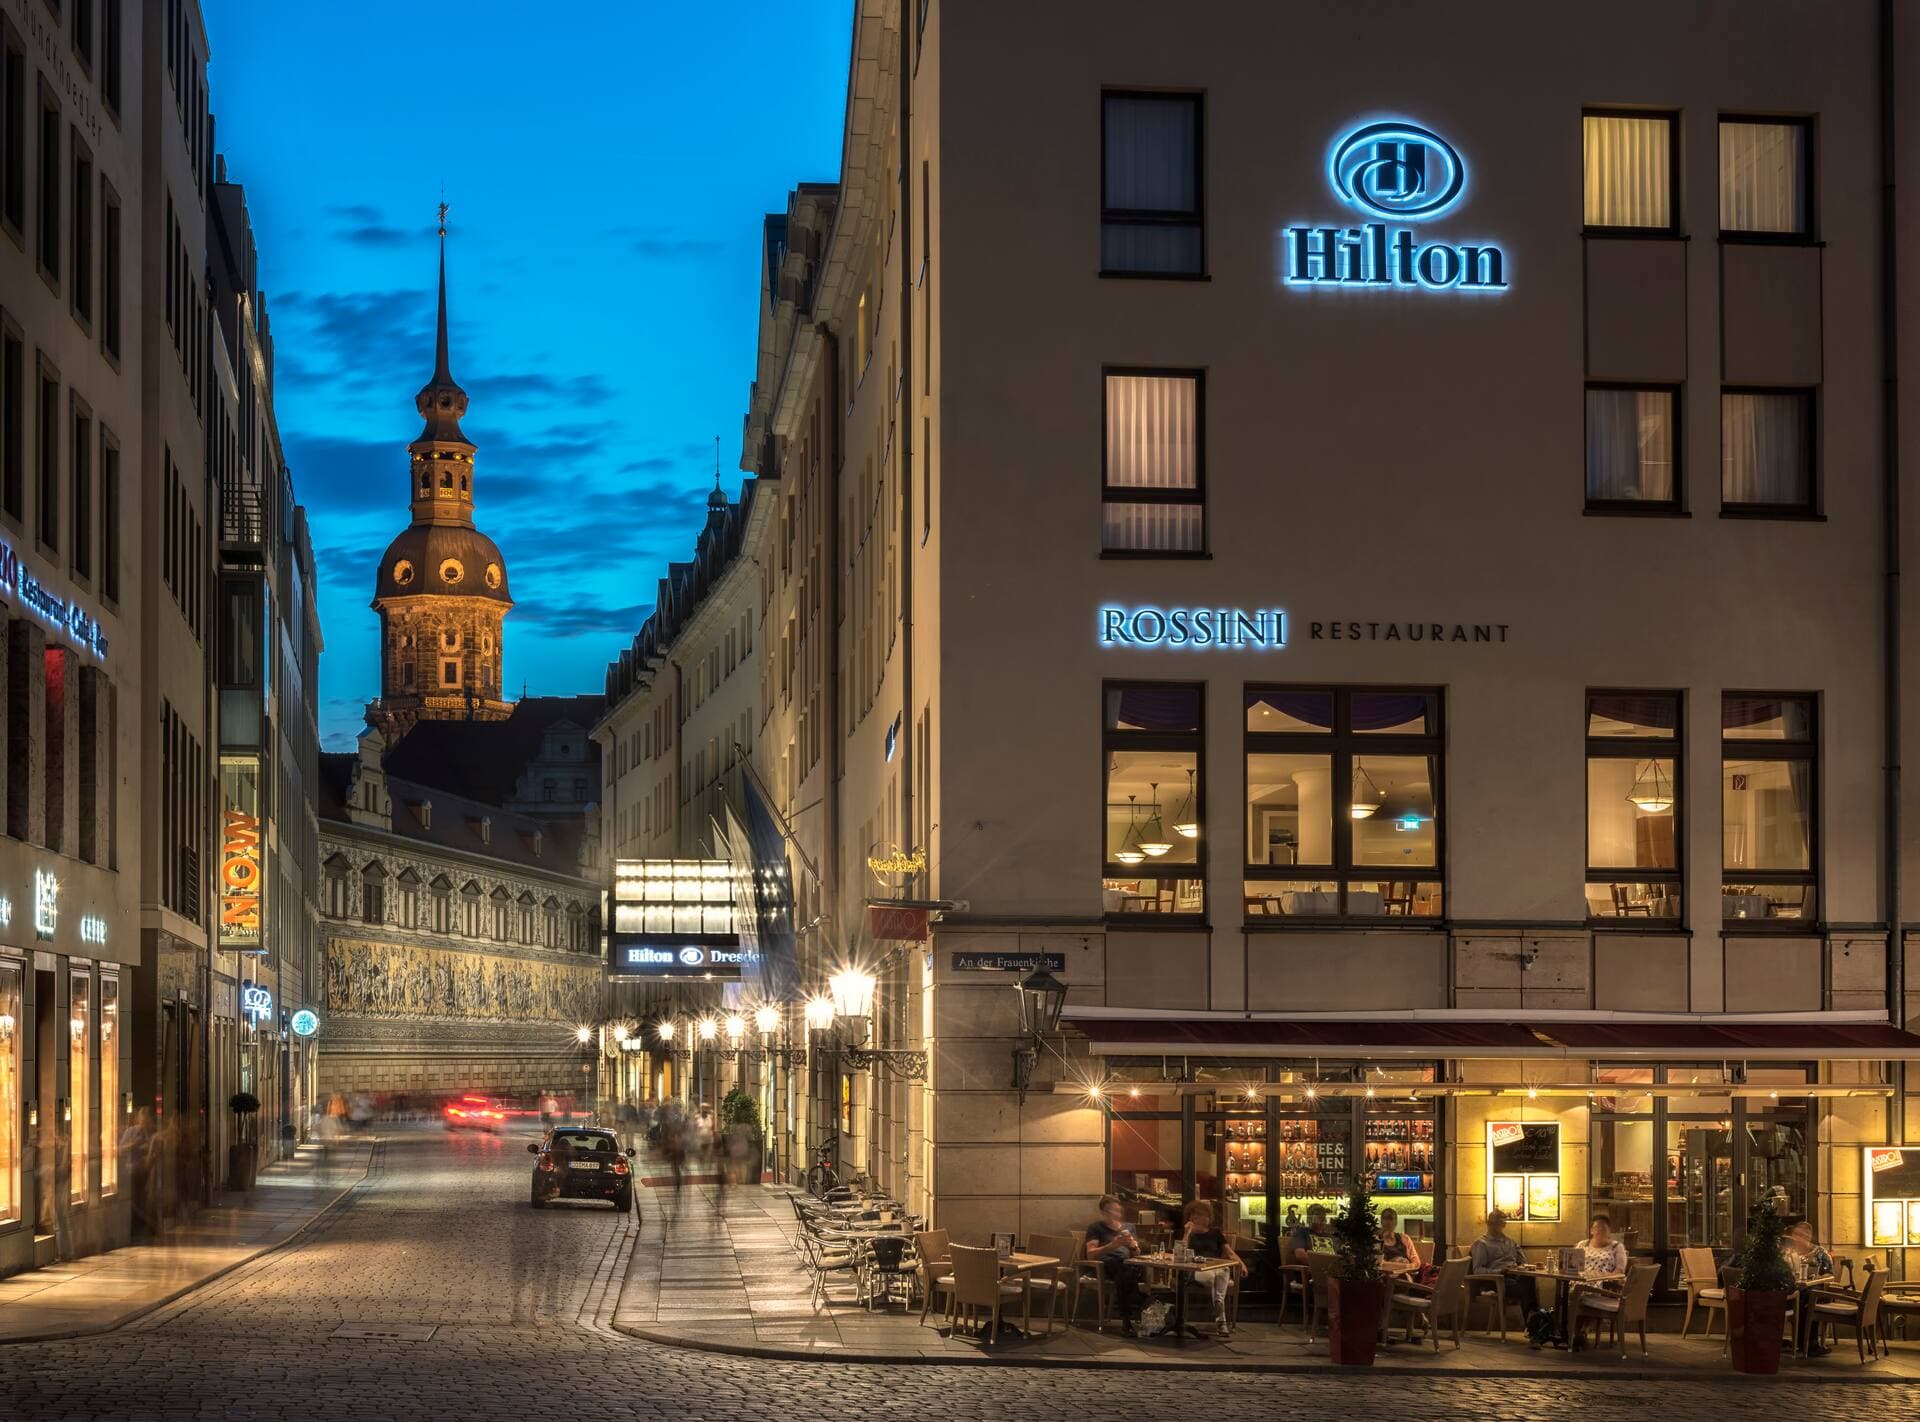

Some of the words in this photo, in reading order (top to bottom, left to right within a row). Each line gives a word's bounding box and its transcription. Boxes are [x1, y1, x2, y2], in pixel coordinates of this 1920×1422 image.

[1287, 223, 1508, 288] Hilton
[0, 541, 17, 588] IO
[1102, 608, 1288, 646] ROSSINI
[1309, 621, 1510, 643] RESTAURANT
[628, 949, 674, 963] Hilton
[710, 950, 769, 964] Dresden
[959, 957, 974, 968] An
[977, 957, 993, 968] der
[997, 957, 1059, 968] Frauenkihe
